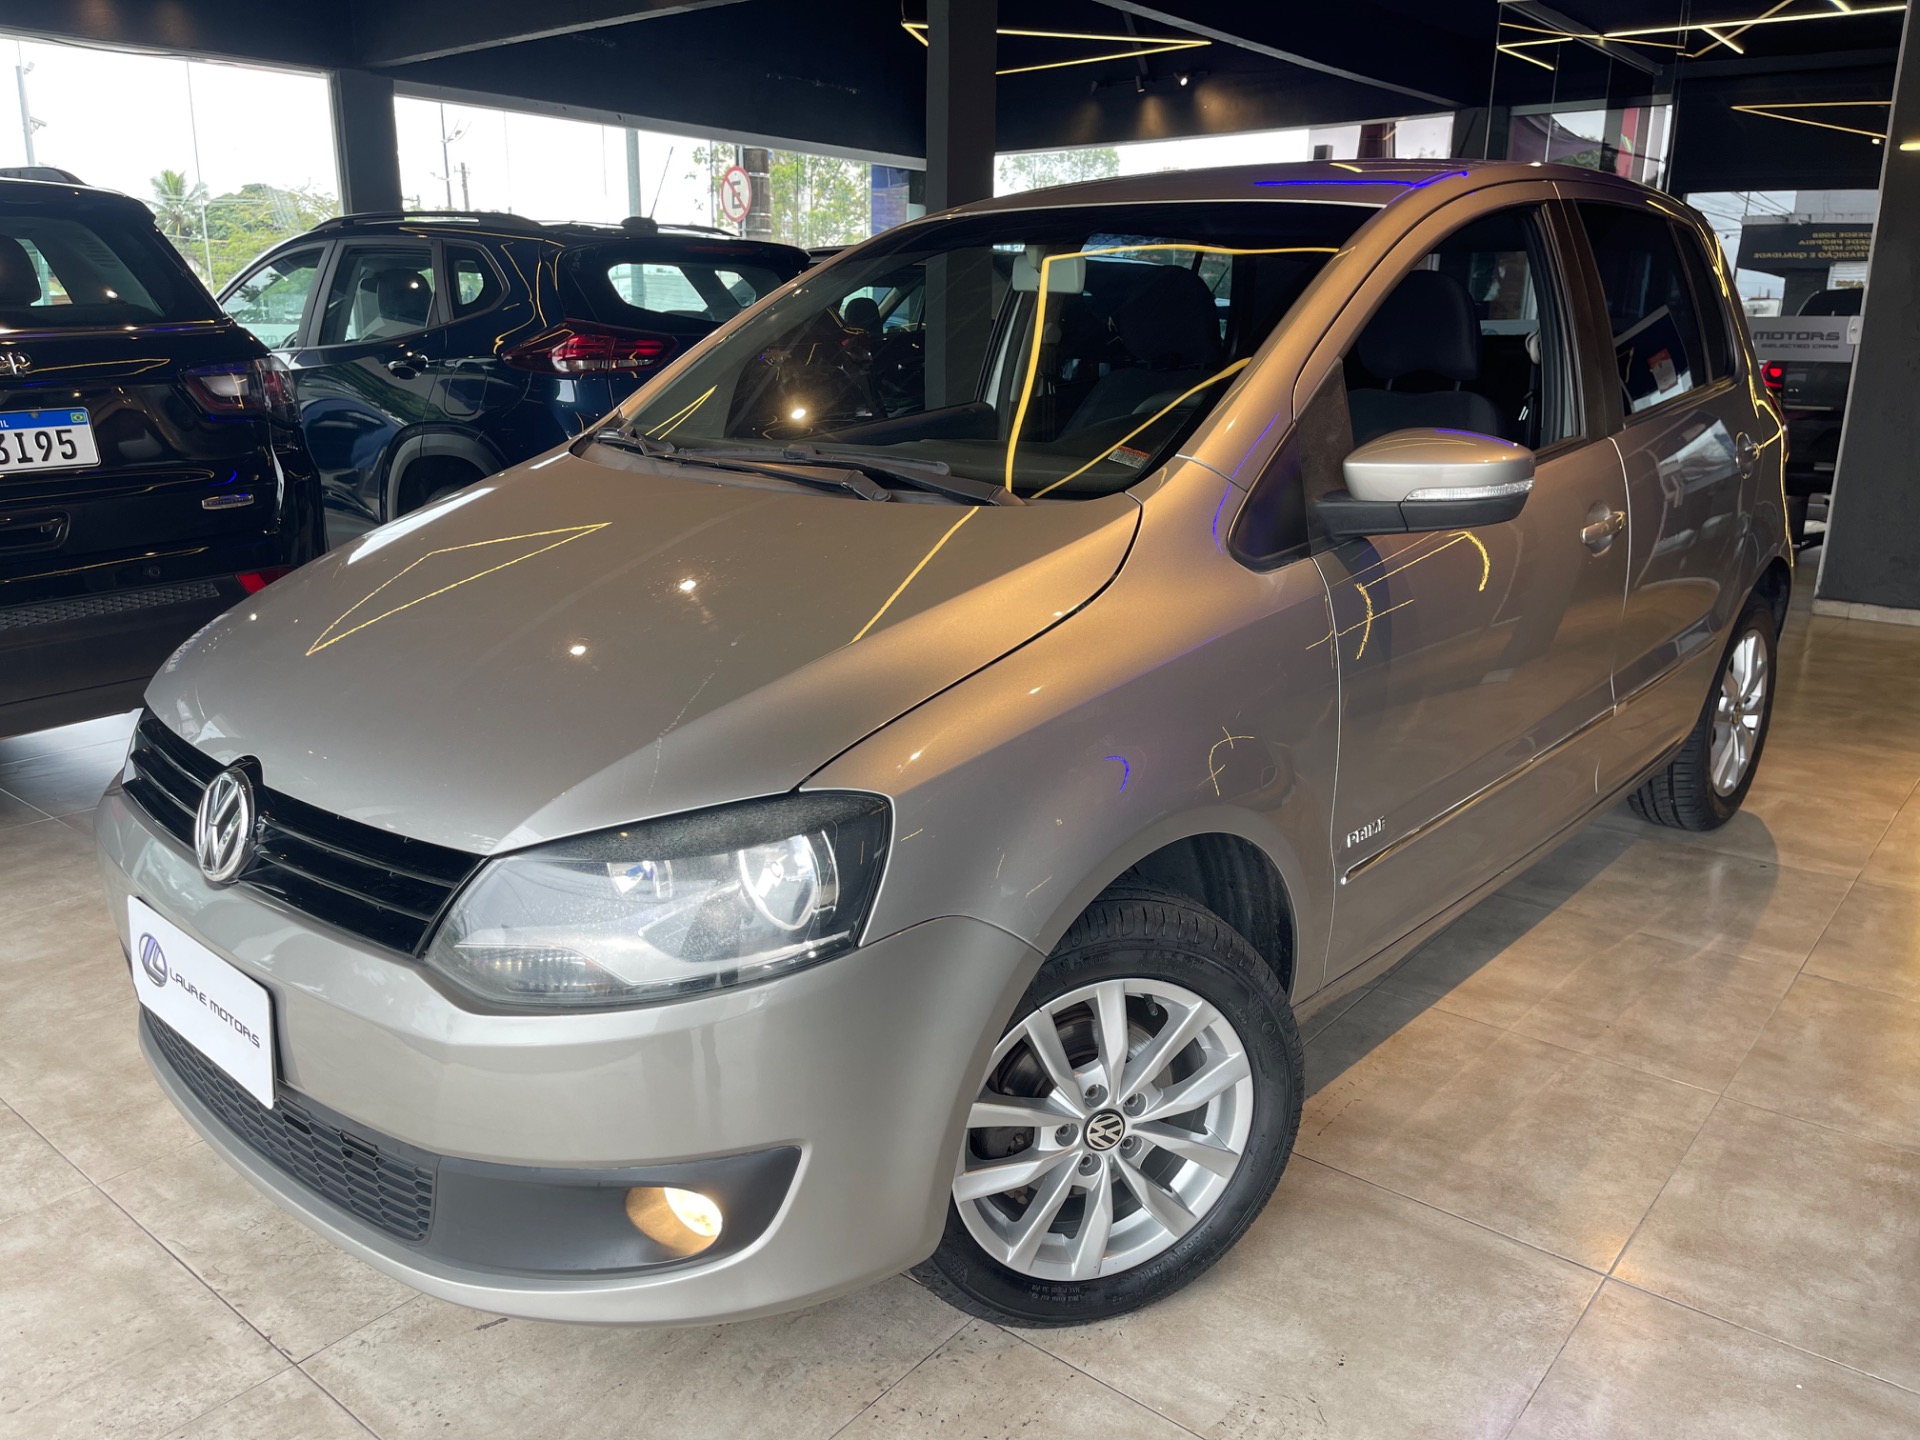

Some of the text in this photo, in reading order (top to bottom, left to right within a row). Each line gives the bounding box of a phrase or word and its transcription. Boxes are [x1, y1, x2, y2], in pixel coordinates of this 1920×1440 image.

[1753, 331, 1840, 341] MOTORS
[1347, 815, 1386, 849] PRIME
[169, 967, 207, 1006] LAURE
[209, 999, 260, 1049] MOTORS
